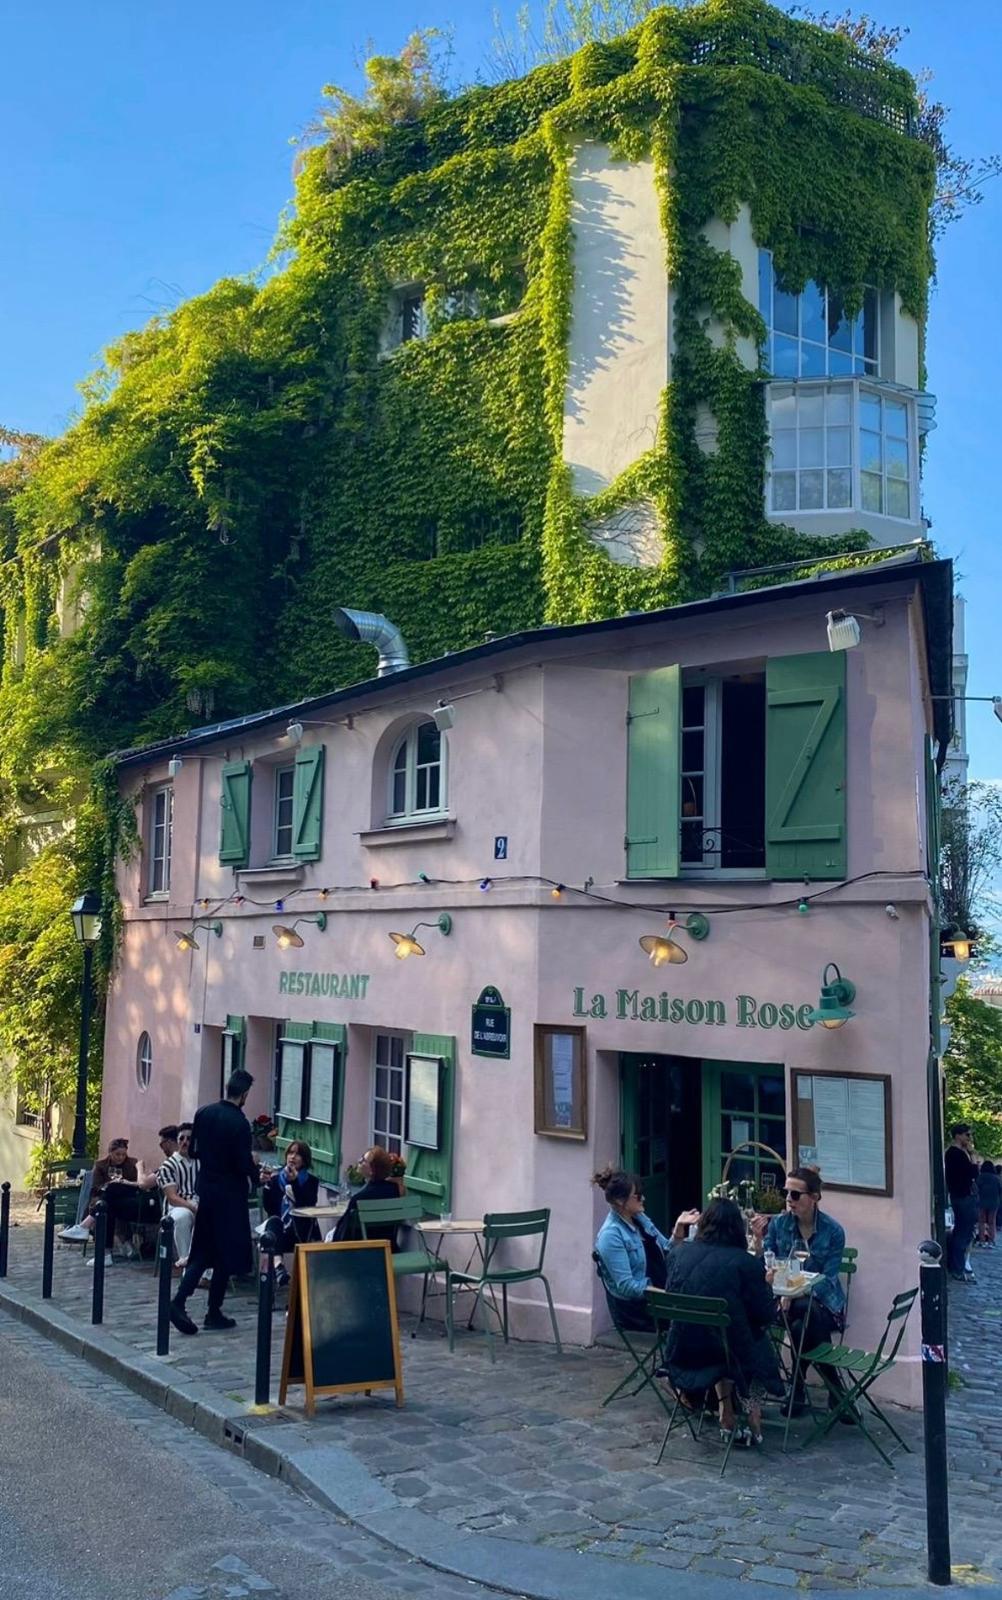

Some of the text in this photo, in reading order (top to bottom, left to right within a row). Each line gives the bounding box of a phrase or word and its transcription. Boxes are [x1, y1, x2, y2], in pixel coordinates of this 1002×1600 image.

[496, 838, 505, 858] 2
[279, 971, 370, 1000] RESTAURANT
[573, 987, 816, 1031] La Maison Rose
[485, 1018, 495, 1027] RUE
